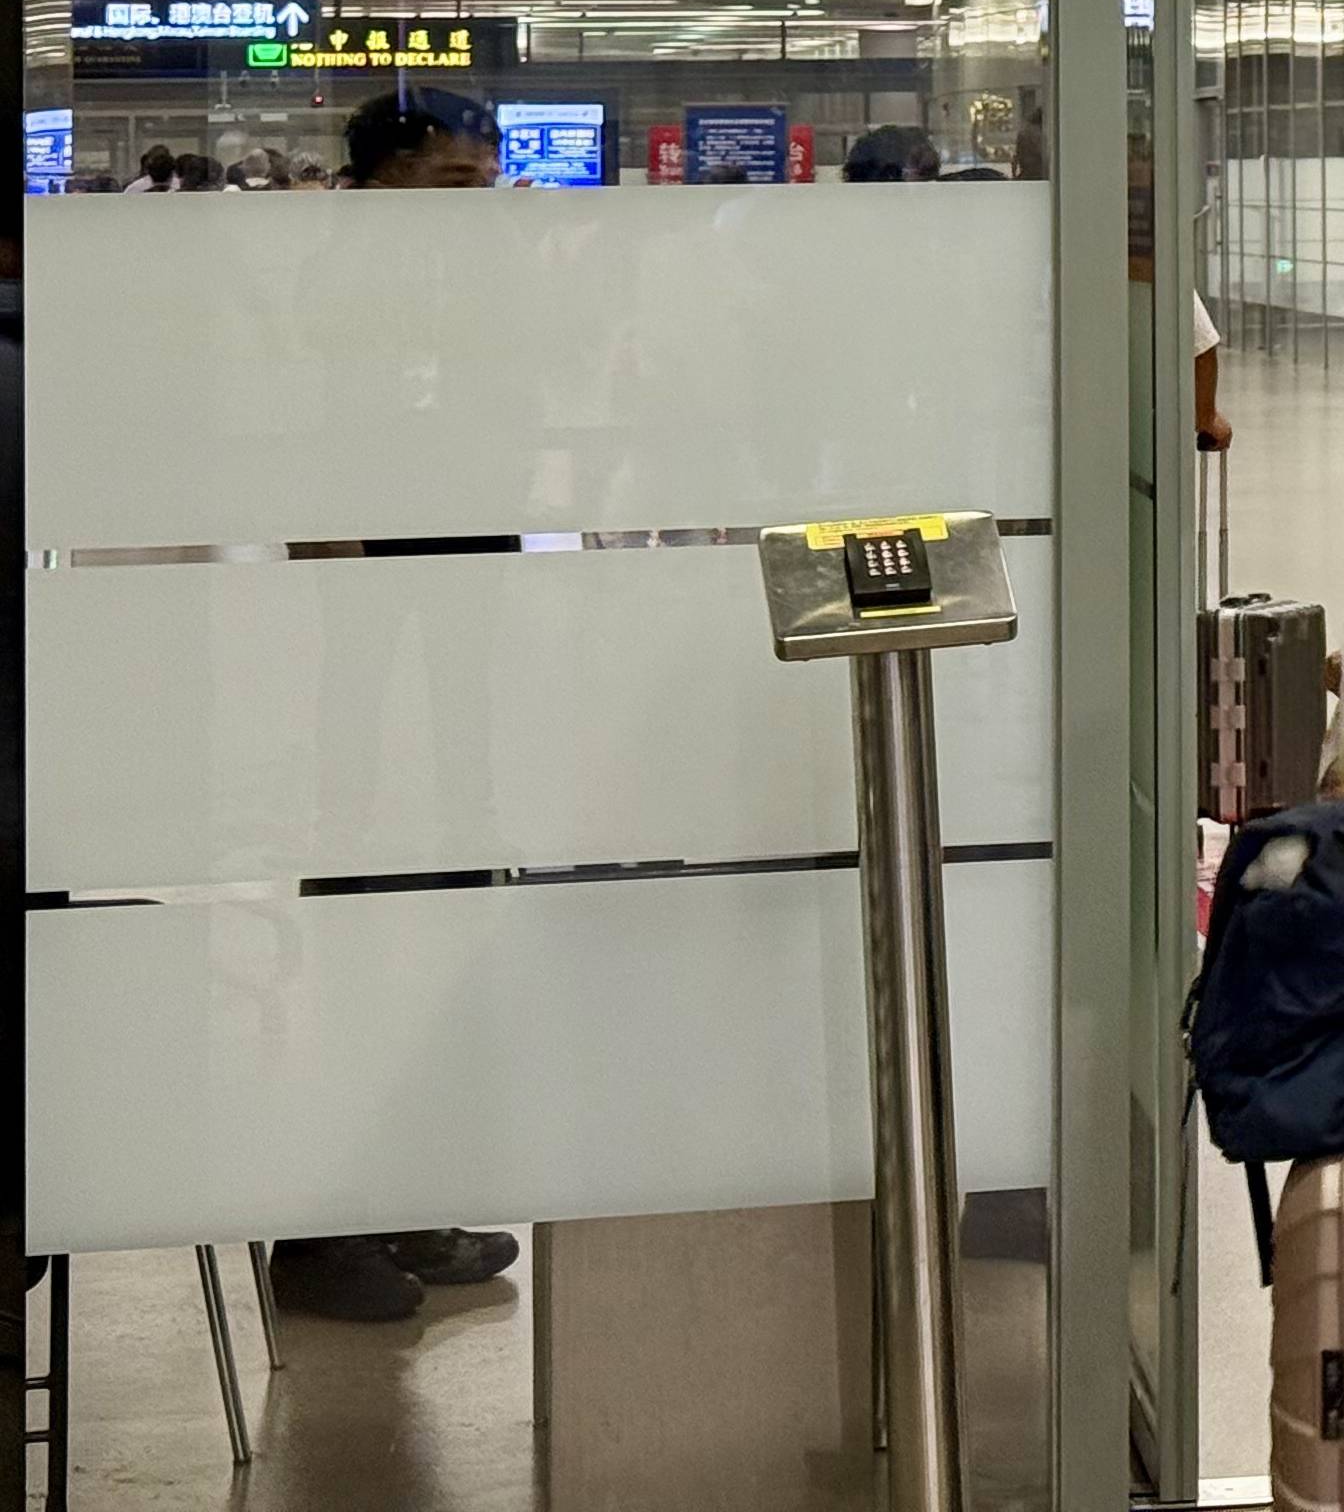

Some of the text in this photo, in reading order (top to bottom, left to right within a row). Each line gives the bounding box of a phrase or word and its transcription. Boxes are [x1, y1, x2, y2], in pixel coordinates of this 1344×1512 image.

[291, 52, 471, 66] NOTHING TO DECLARE
